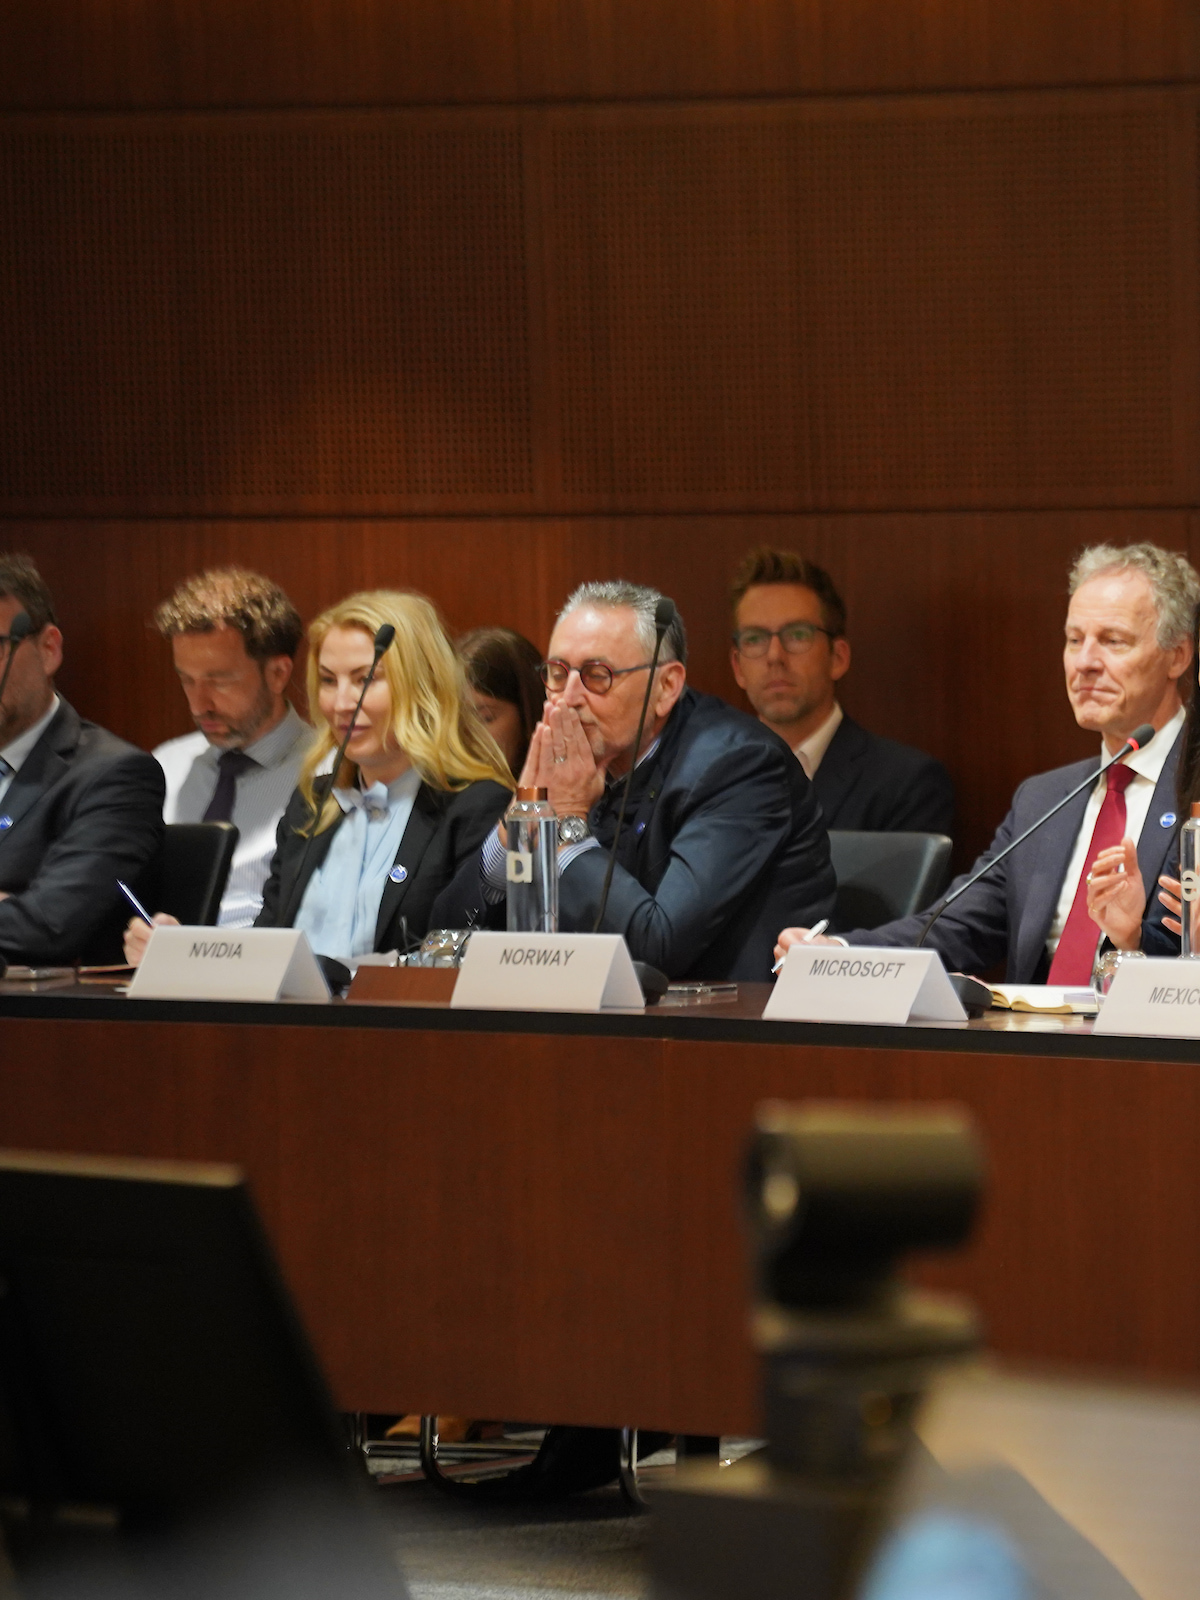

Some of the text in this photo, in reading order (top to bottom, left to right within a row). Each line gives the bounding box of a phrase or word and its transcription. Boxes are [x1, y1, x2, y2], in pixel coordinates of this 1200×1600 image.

[189, 942, 243, 959] NVIDIA
[499, 948, 575, 966] NORWAY
[809, 959, 906, 979] MICROSOFT
